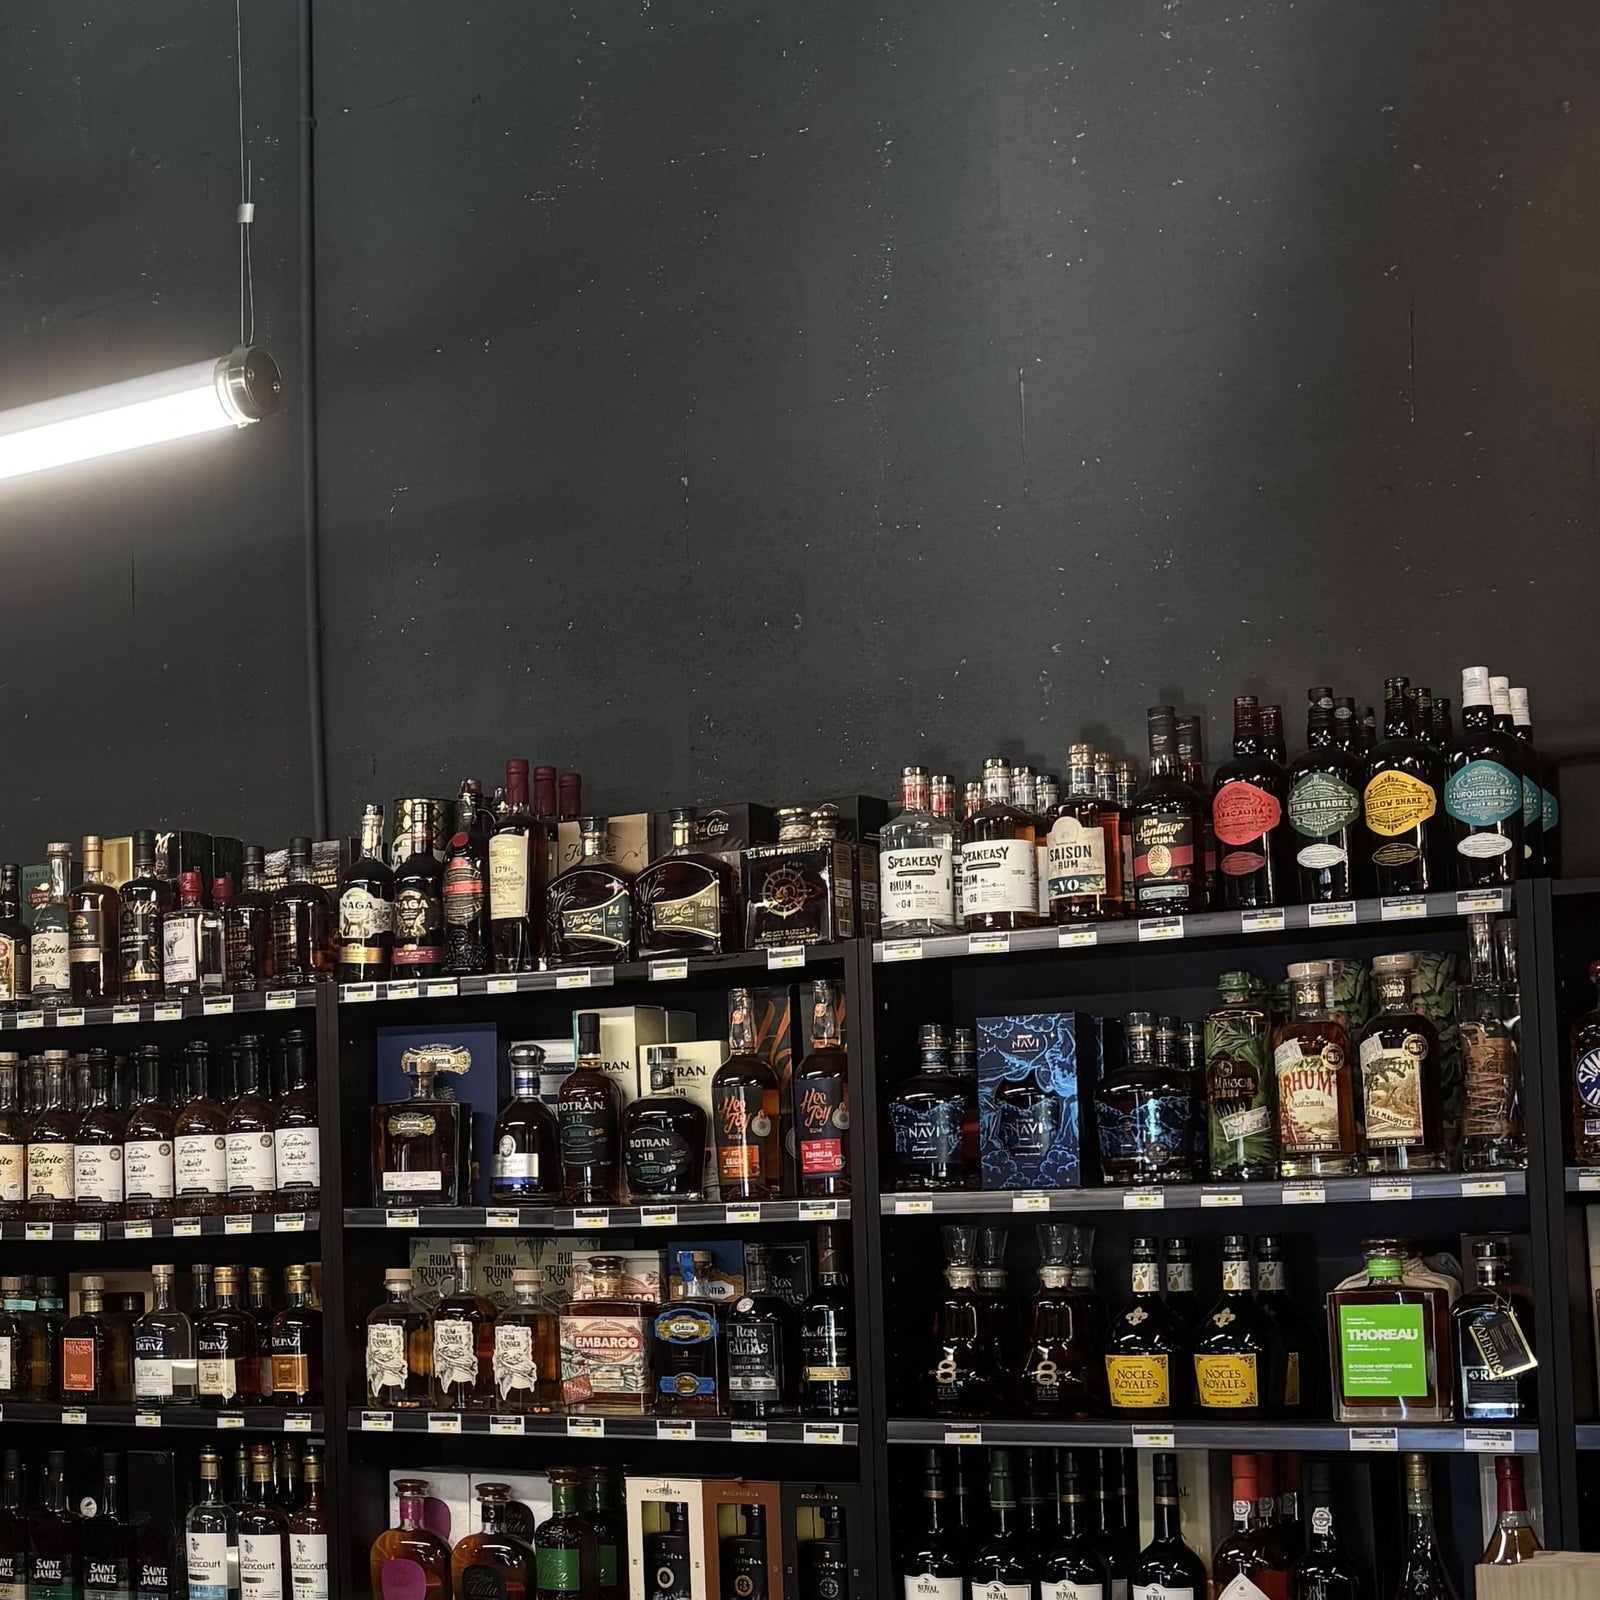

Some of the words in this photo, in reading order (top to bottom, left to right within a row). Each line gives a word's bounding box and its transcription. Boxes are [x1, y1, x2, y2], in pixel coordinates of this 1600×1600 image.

[1136, 822, 1184, 842] Santiago
[962, 846, 1010, 863] SPEAKEASY
[1050, 844, 1092, 862] SAISON
[888, 855, 943, 870] SPEAKEASY
[342, 901, 373, 910] NAGA
[396, 899, 428, 909] NAGA
[1012, 1038, 1039, 1050] NAVI
[1281, 1071, 1333, 1100] RHUM
[908, 1127, 940, 1139] NAVI
[429, 1254, 451, 1266] RUM
[495, 1254, 517, 1266] RUM
[1346, 1328, 1418, 1341] THOREAU
[575, 1336, 640, 1349] EMBARGO
[1117, 1369, 1154, 1379] NOCES
[1205, 1369, 1241, 1379] NOCES
[1114, 1378, 1159, 1390] ROYALES
[1203, 1378, 1246, 1390] ROYALES
[36, 1558, 61, 1568] SAINT
[90, 1563, 116, 1574] SAINT
[34, 1567, 62, 1579] JAMES
[143, 1565, 168, 1576] SAINT
[88, 1573, 117, 1584] JAMES
[140, 1575, 168, 1586] JAMES
